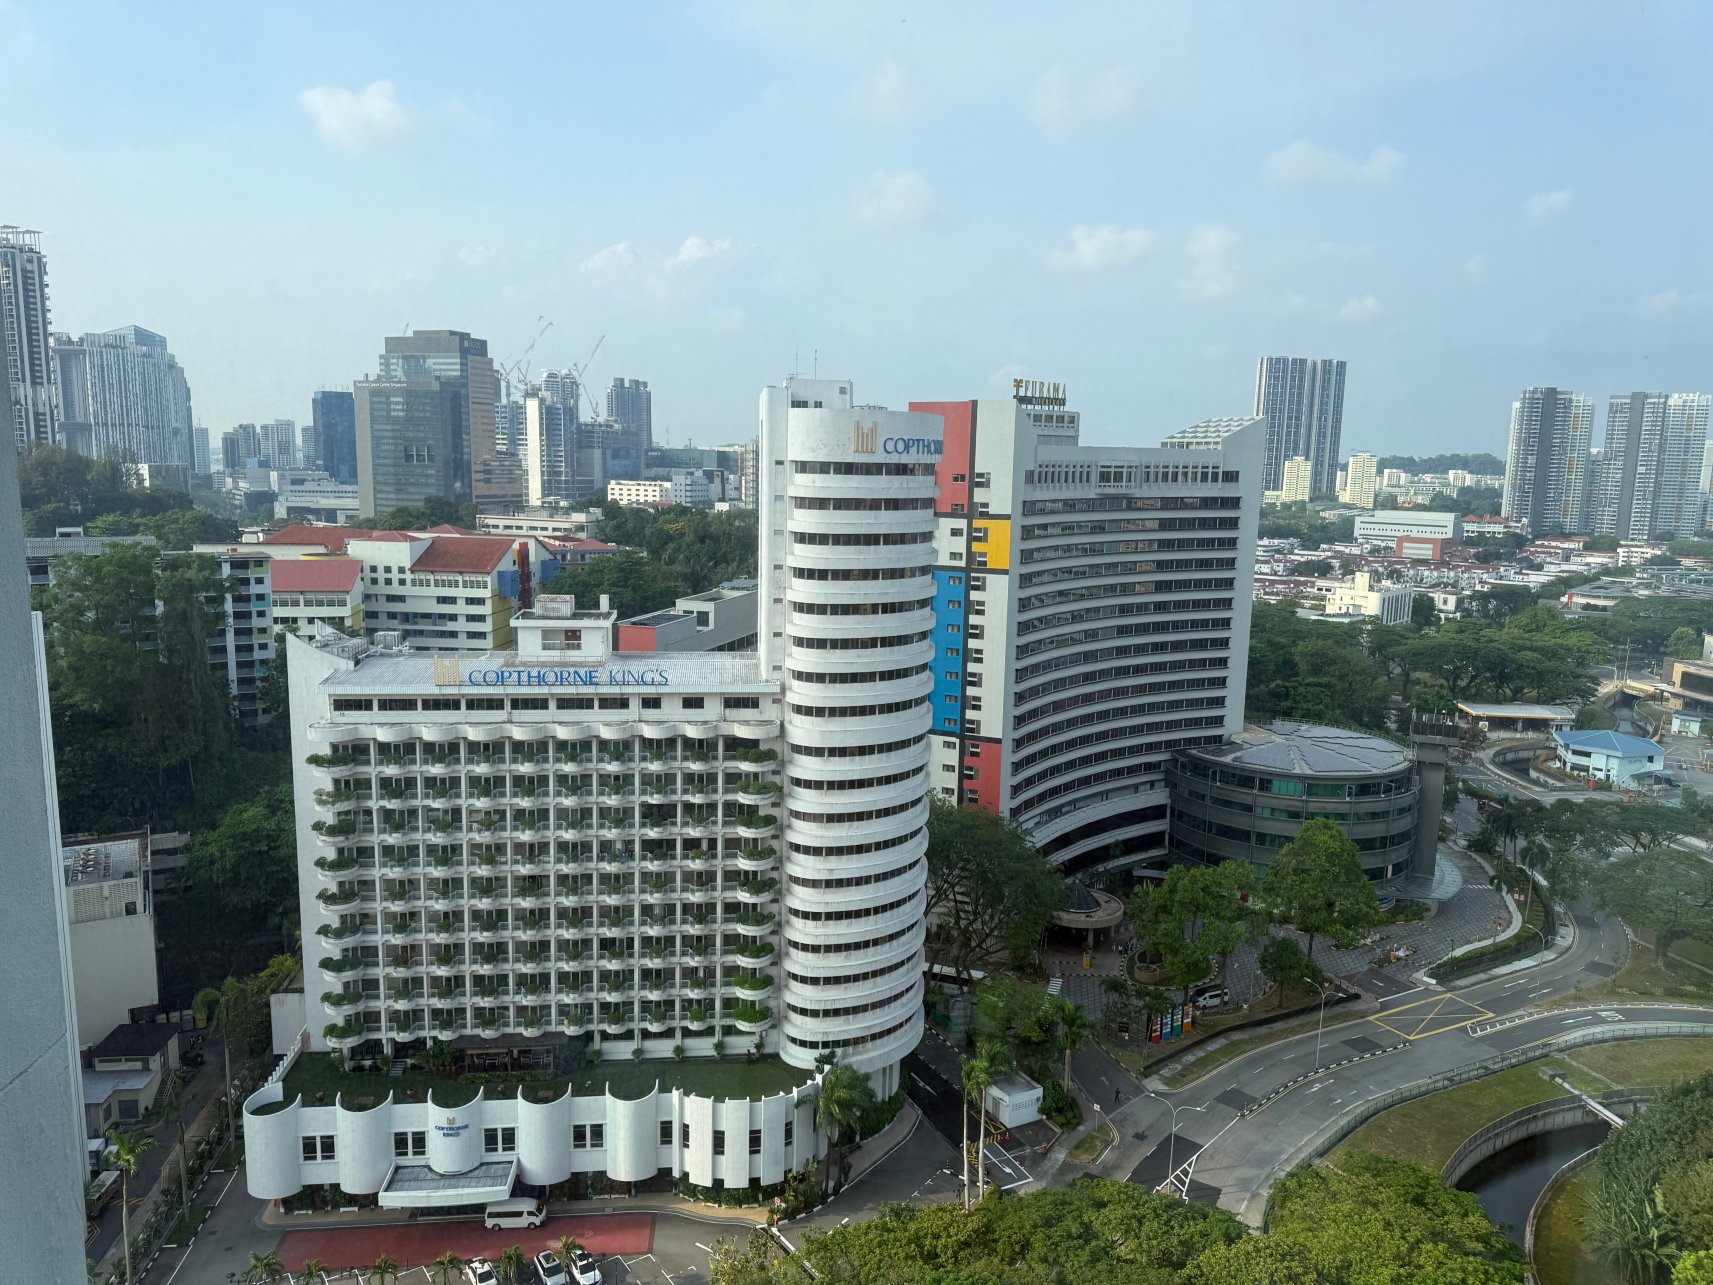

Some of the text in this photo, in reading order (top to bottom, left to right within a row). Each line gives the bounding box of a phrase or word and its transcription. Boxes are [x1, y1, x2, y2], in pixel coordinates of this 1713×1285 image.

[1024, 379, 1066, 400] FURAMA
[468, 669, 669, 686] COPTHORNE KING'S
